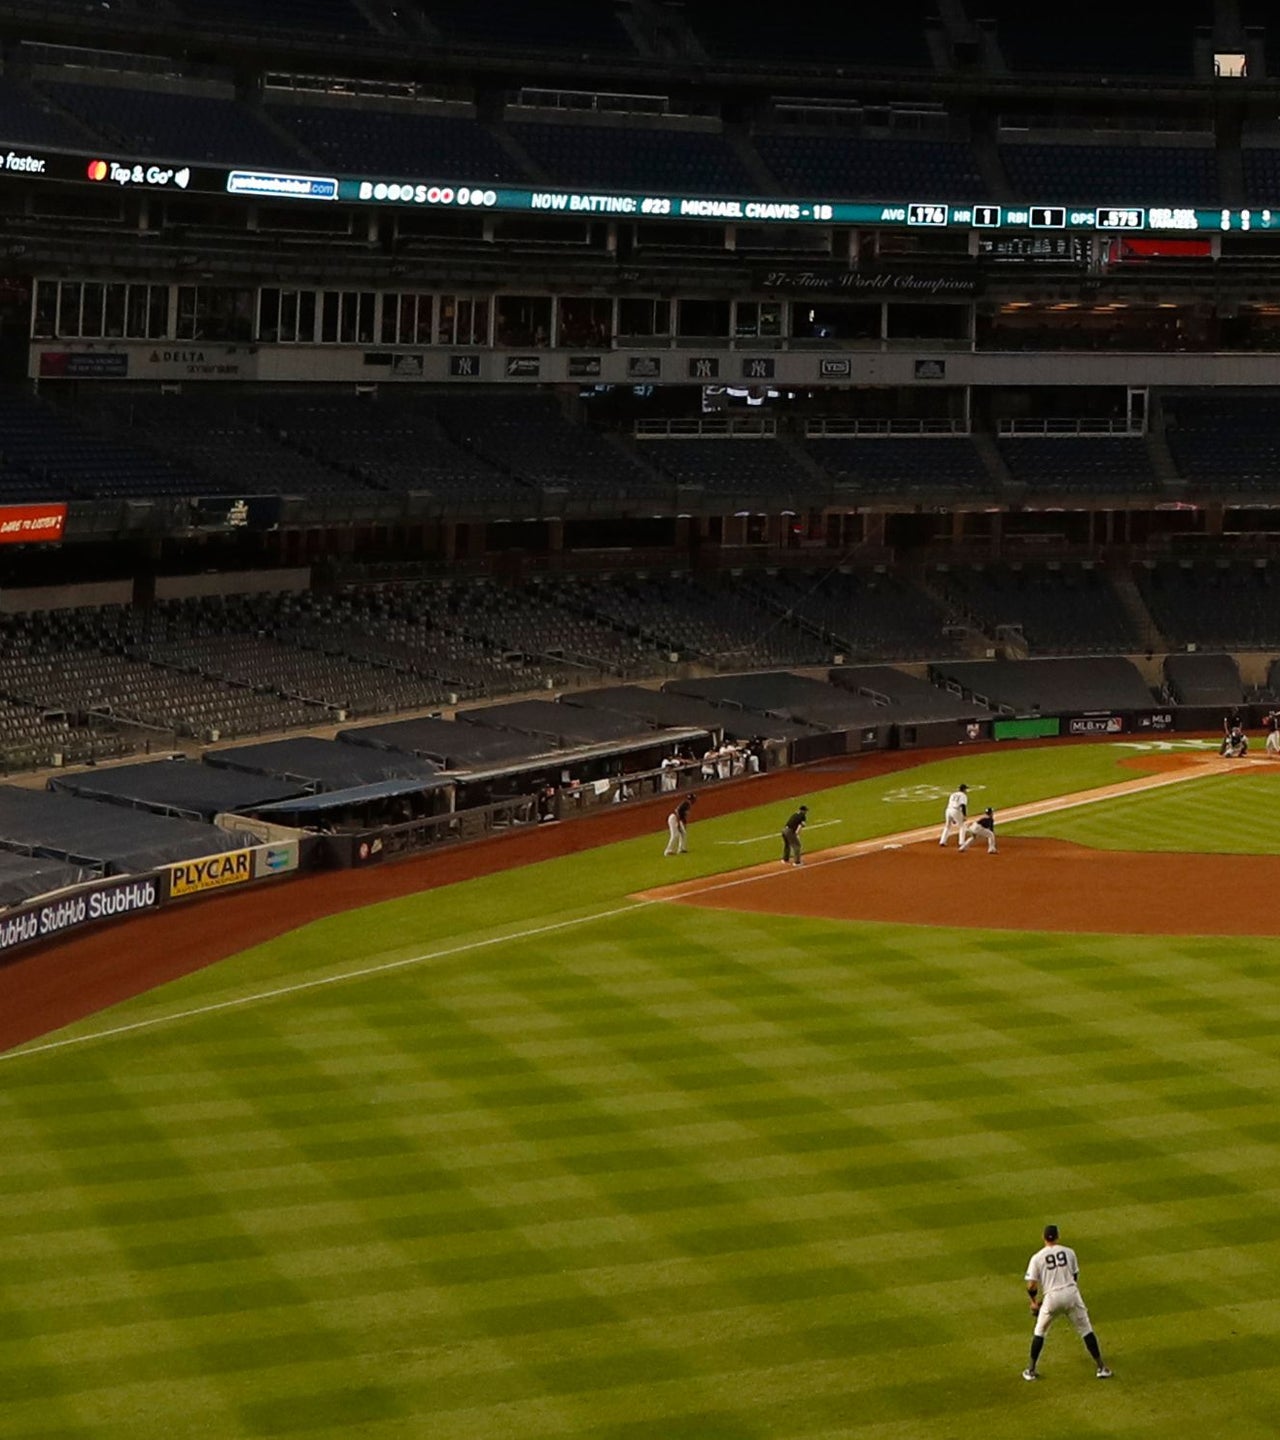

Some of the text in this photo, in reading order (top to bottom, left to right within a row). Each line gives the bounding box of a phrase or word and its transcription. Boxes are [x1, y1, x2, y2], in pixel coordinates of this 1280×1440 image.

[6, 151, 46, 173] faster.
[109, 162, 131, 185] Tap
[131, 165, 144, 183] &
[532, 193, 568, 210] NOW
[571, 194, 637, 212] BATTING:
[641, 198, 671, 214] #23
[681, 200, 743, 218] MICHAEL
[746, 203, 800, 219] CHAVIS
[814, 204, 833, 220] 1B
[881, 208, 906, 222] AVG
[910, 207, 945, 223] .176
[954, 210, 970, 223] HR
[983, 209, 991, 224] 1
[1007, 210, 1028, 224] RBI
[1043, 210, 1052, 225] 1
[1071, 211, 1095, 225] OPS
[763, 272, 977, 296] 27-Time World Champions
[163, 351, 205, 362] DELTA
[1152, 714, 1172, 723] MLB
[173, 854, 248, 887] PLYCAR
[0, 883, 156, 949] tubHub StubHub StubHub
[1045, 1251, 1068, 1270] 99
